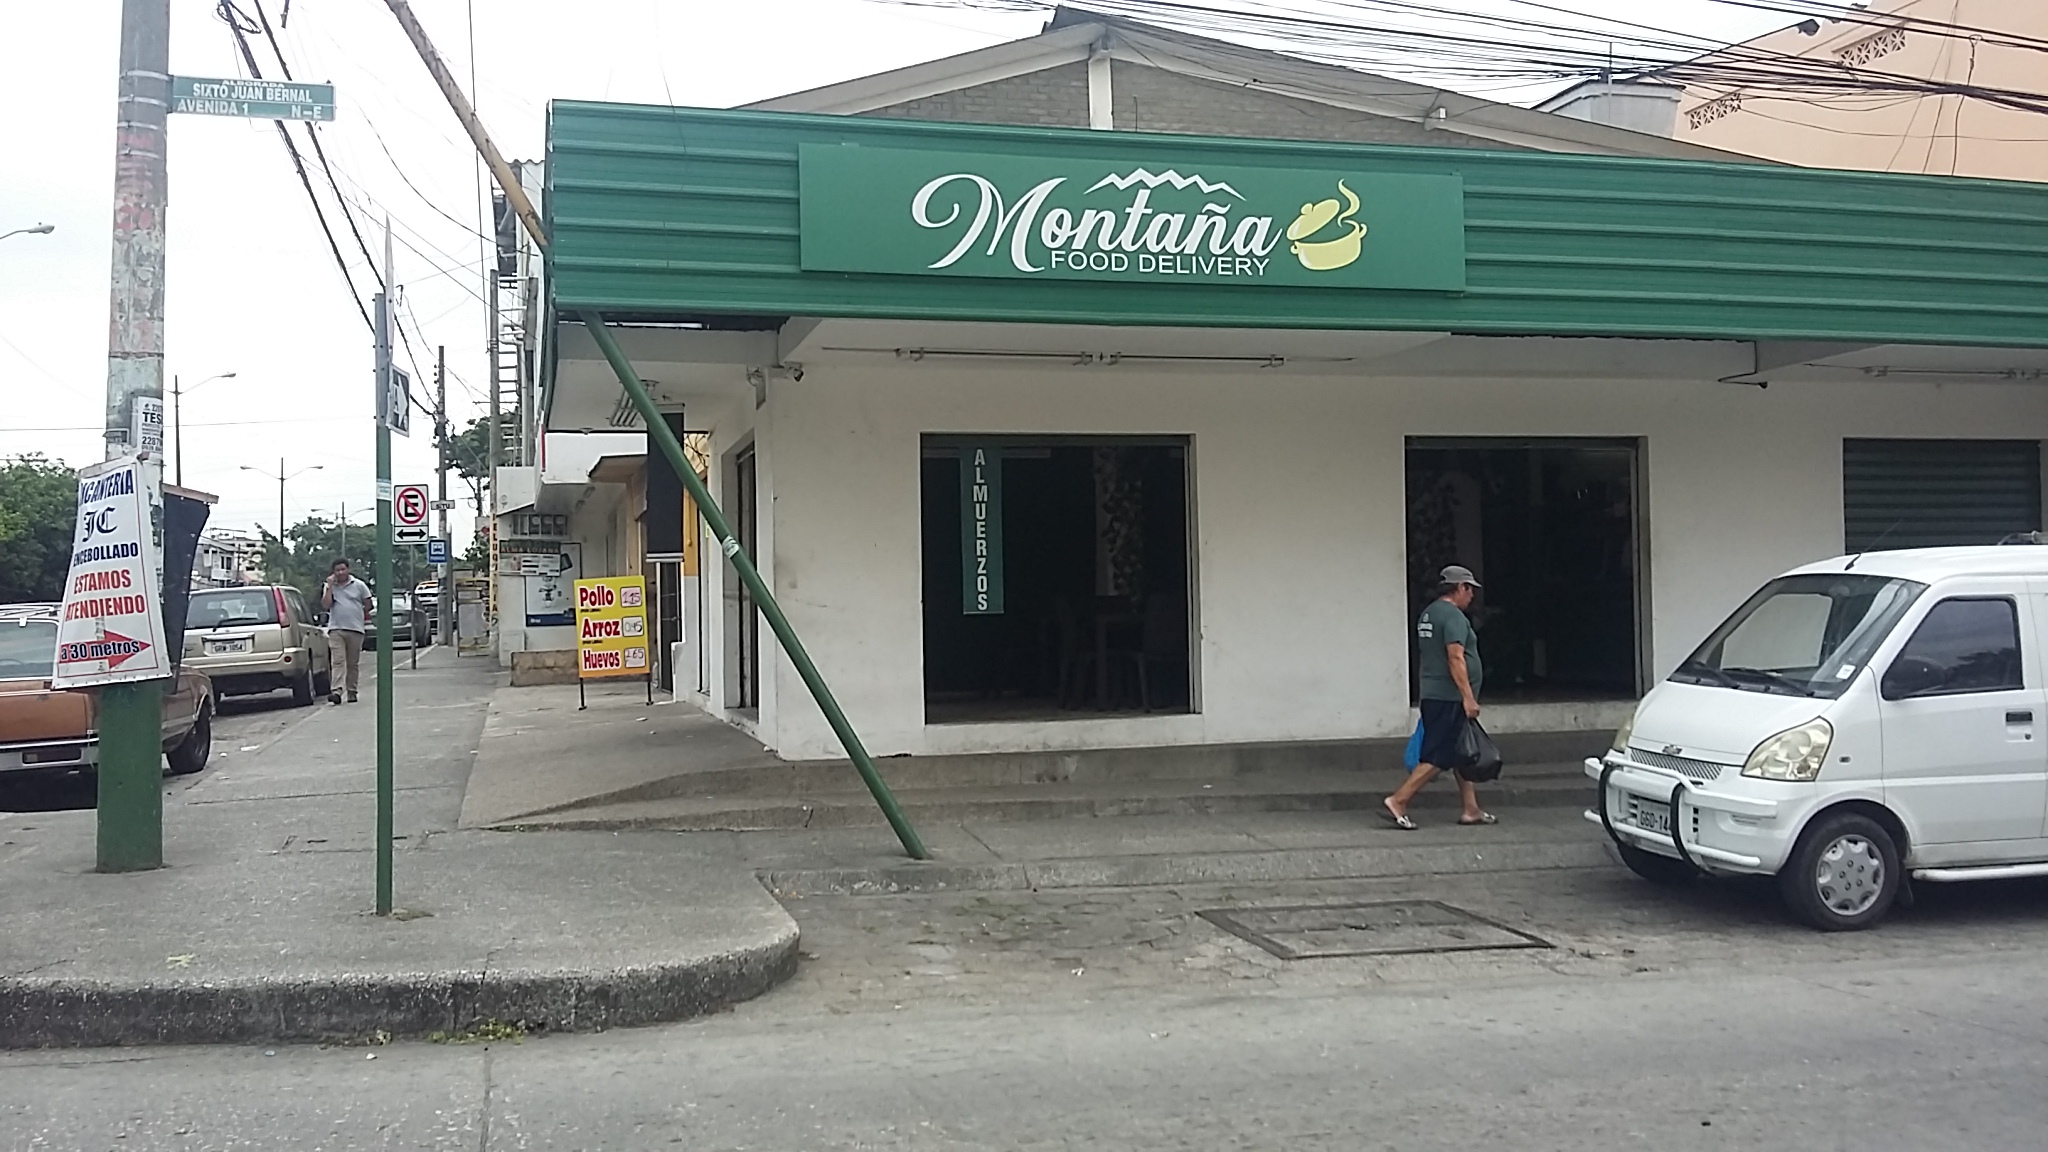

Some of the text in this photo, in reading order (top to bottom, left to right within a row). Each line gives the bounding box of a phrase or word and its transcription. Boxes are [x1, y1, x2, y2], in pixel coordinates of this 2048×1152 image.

[192, 83, 313, 103] SIXTO JUAN BERNAL
[177, 98, 238, 115] AVENIDA
[242, 103, 249, 116] 1
[911, 173, 1282, 272] Montaña
[1050, 250, 1270, 276] FOOD DELIVERY
[973, 449, 988, 610] ALMUERZOS
[73, 543, 138, 567] ENCEBOLLADO
[74, 569, 131, 594] ESTAMOS
[580, 586, 614, 607] Pollo
[65, 595, 145, 621] ATENDIENDO
[582, 619, 620, 638] Arroz
[70, 644, 87, 659] 30
[90, 641, 140, 656] metros
[583, 650, 620, 669] Huevos
